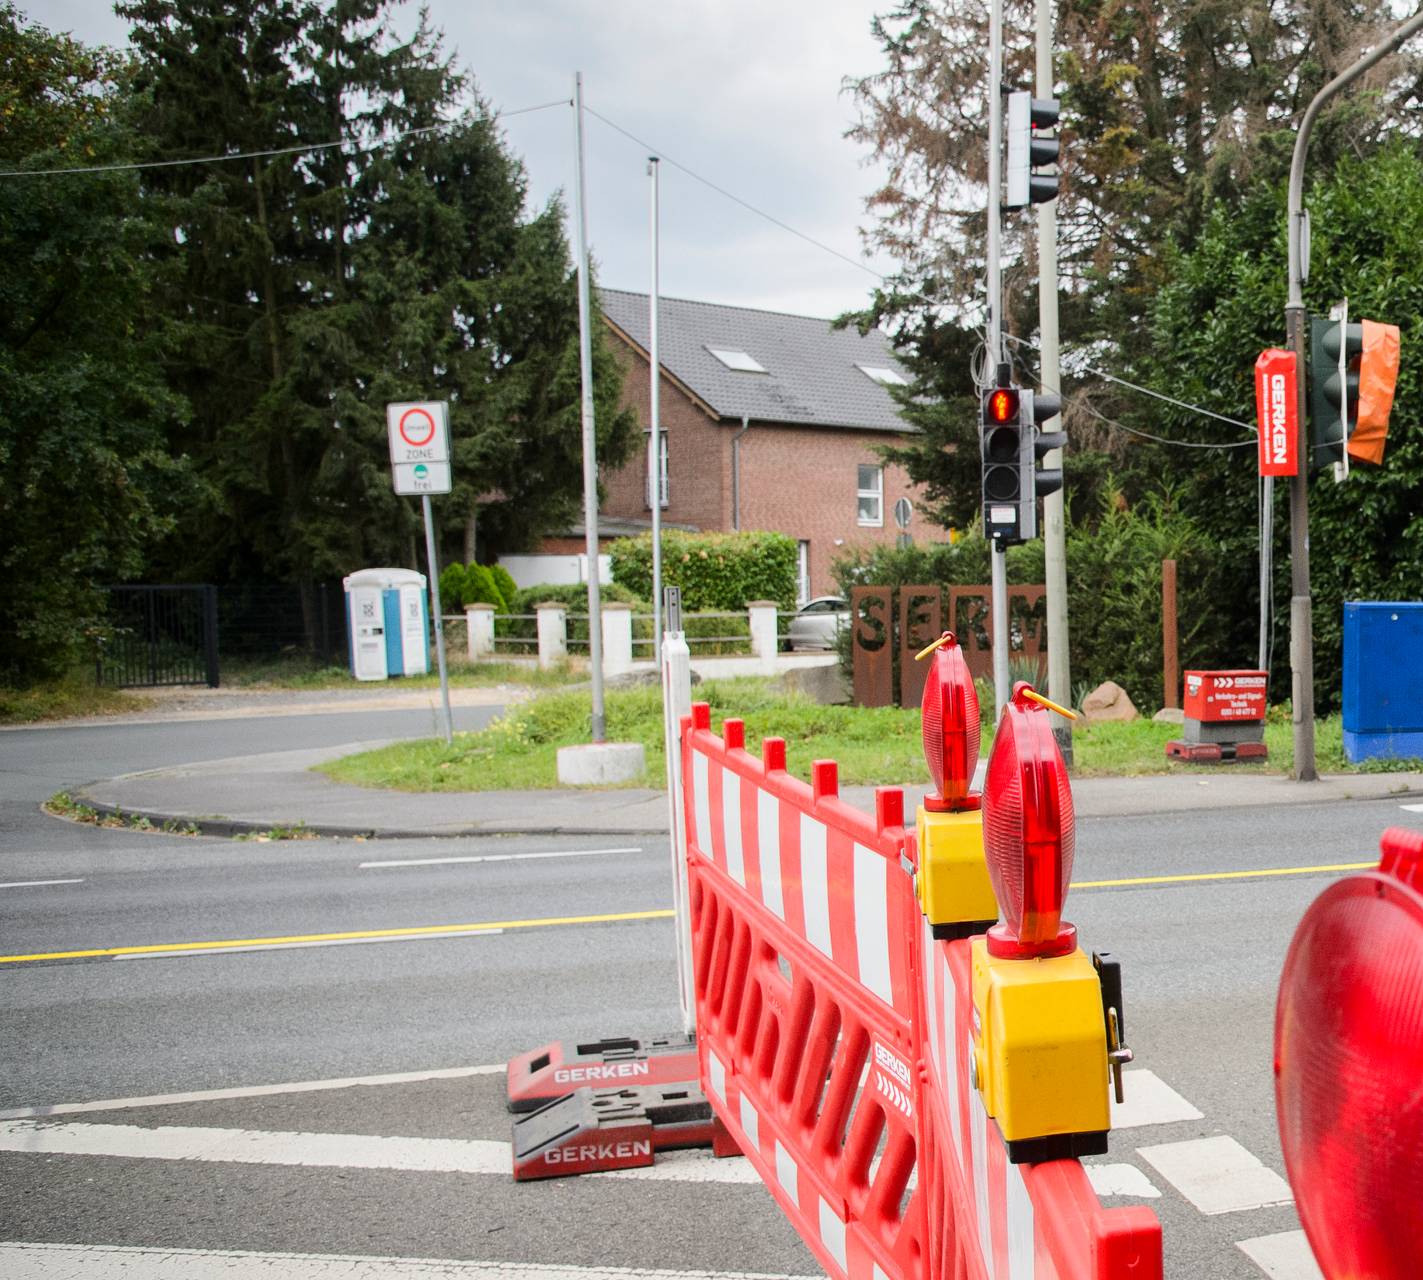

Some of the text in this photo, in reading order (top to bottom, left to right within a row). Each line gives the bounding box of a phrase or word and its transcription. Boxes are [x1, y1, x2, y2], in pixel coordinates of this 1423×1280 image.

[1272, 374, 1287, 464] GERKEN
[406, 448, 434, 460] ZONE
[414, 480, 433, 490] frei
[857, 595, 1047, 652] SERM
[554, 1062, 649, 1083] GERKEN
[876, 1041, 911, 1085] GERKEN
[544, 1140, 650, 1164] GERKEN
